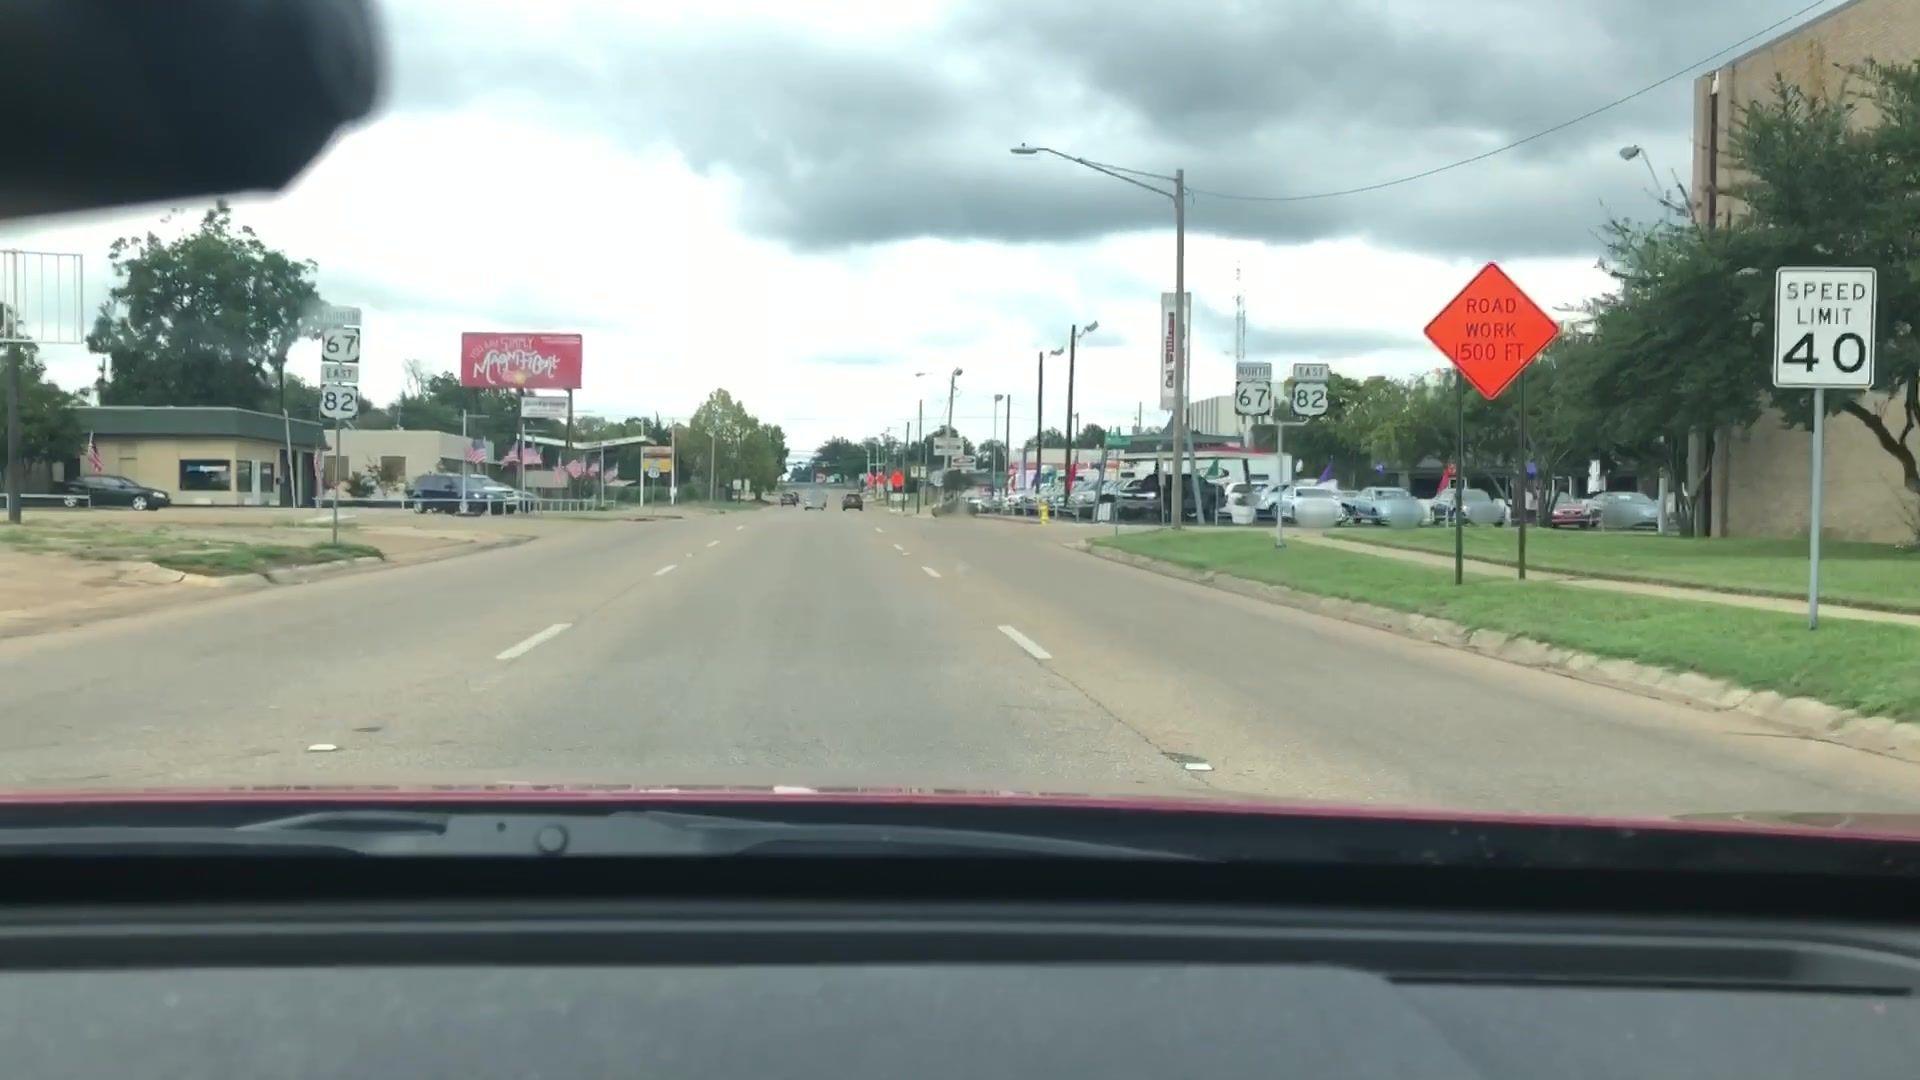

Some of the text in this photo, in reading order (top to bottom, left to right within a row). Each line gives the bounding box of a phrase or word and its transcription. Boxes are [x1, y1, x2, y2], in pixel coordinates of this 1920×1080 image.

[1786, 282, 1866, 301] SPEED
[1466, 298, 1517, 314] ROAD
[1797, 307, 1852, 325] LIMIT
[1466, 322, 1517, 338] WORK
[325, 334, 357, 355] 67
[1455, 343, 1525, 360] 1500 FT
[1782, 332, 1866, 373] 40
[1299, 366, 1325, 377] EAST
[324, 391, 354, 412] 82
[1238, 388, 1268, 408] 67
[1296, 389, 1325, 408] 82
